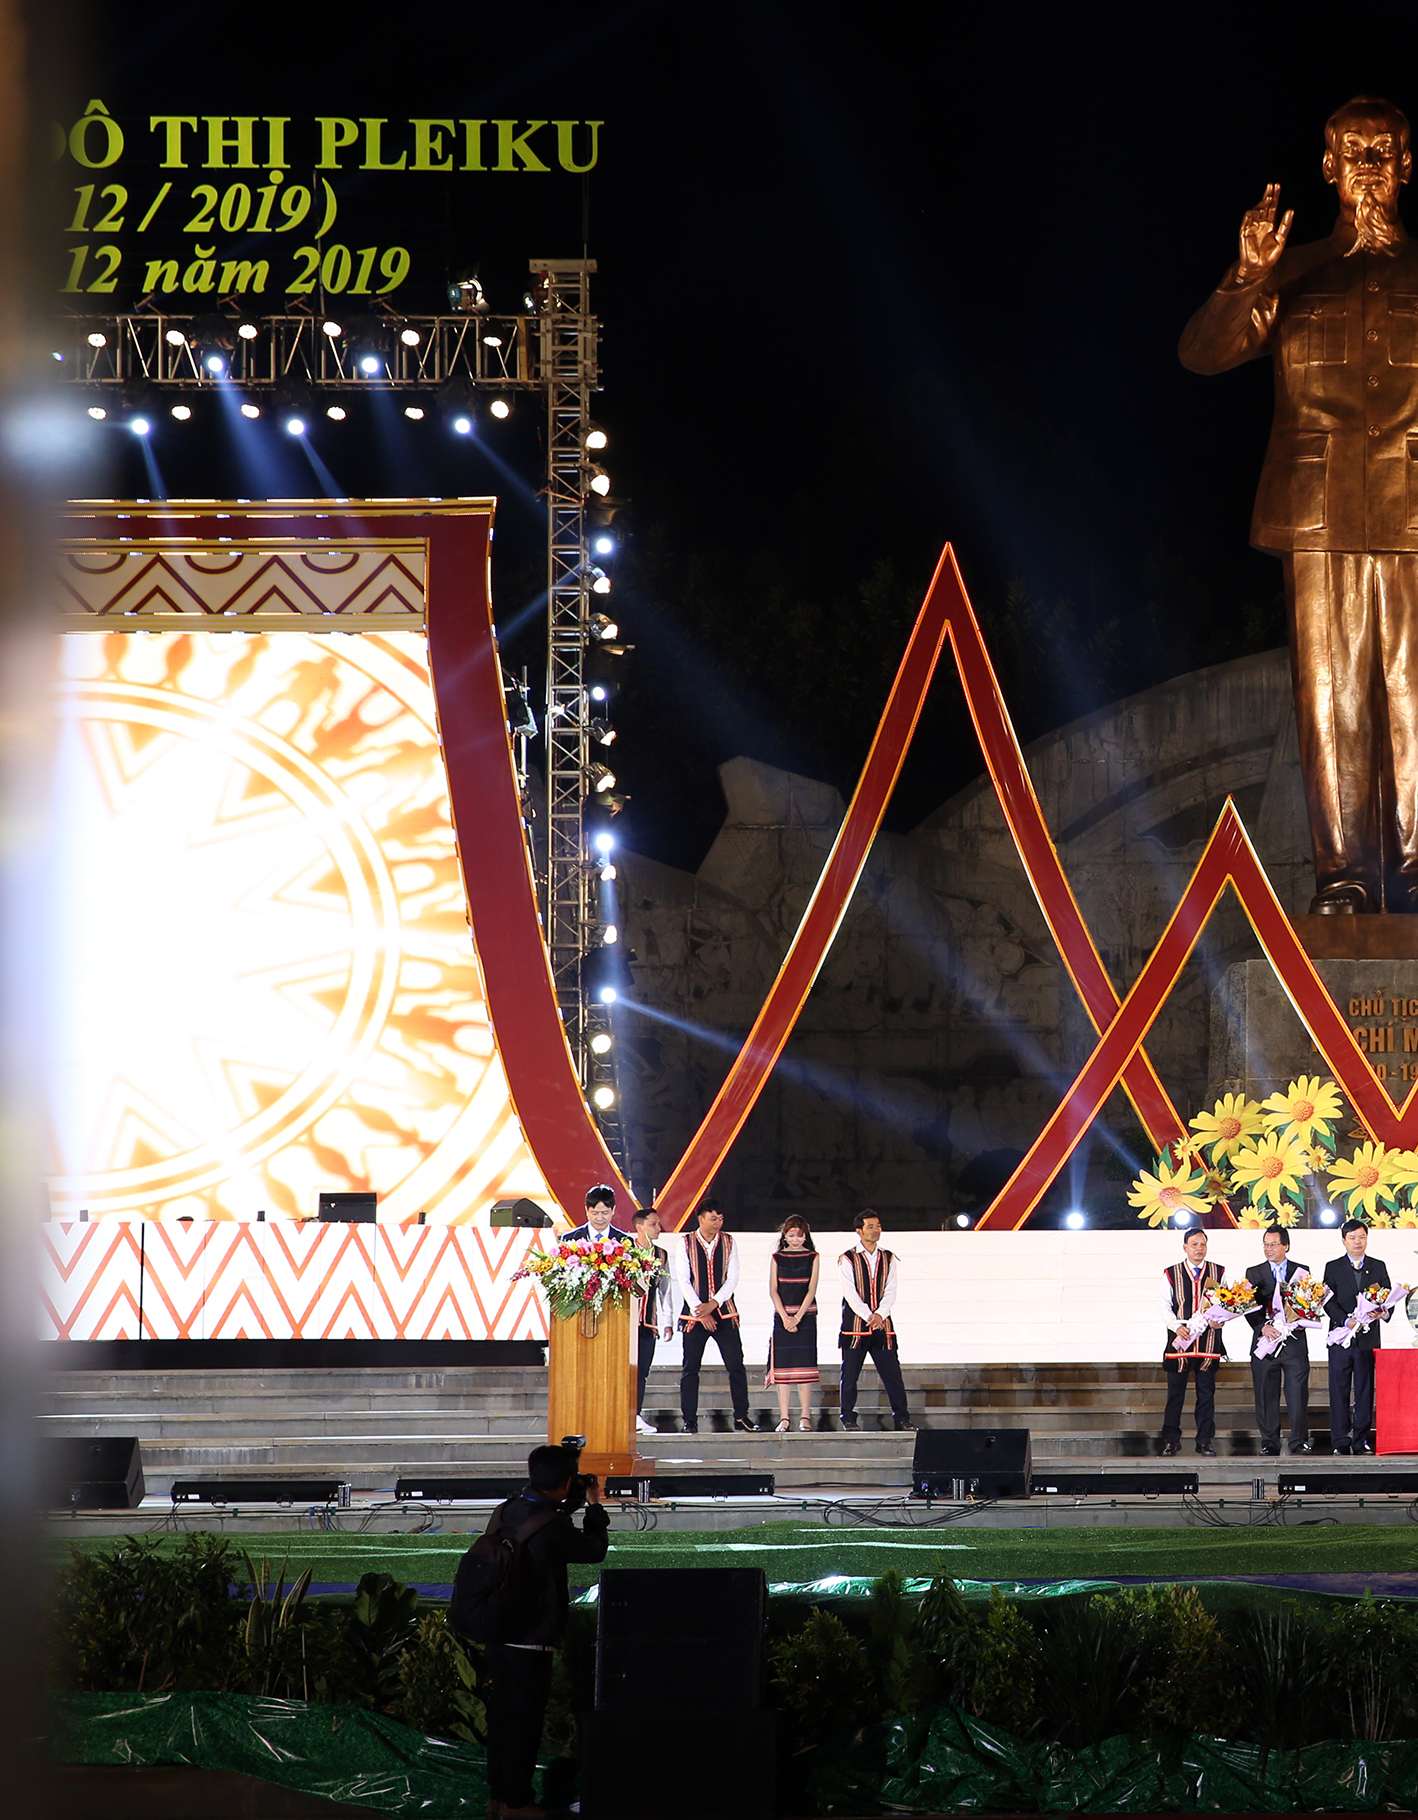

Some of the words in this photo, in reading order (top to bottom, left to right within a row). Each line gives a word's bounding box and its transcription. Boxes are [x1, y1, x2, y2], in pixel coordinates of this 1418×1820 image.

[149, 115, 292, 185] THỊ
[314, 116, 605, 173] PLEIKU
[64, 183, 129, 233] 12
[182, 177, 338, 240] 2019)
[59, 244, 123, 294] 12
[141, 243, 270, 294] năm
[284, 243, 411, 295] 2019
[1348, 990, 1385, 1017] CHỦ
[1351, 1021, 1394, 1053] CHÍ
